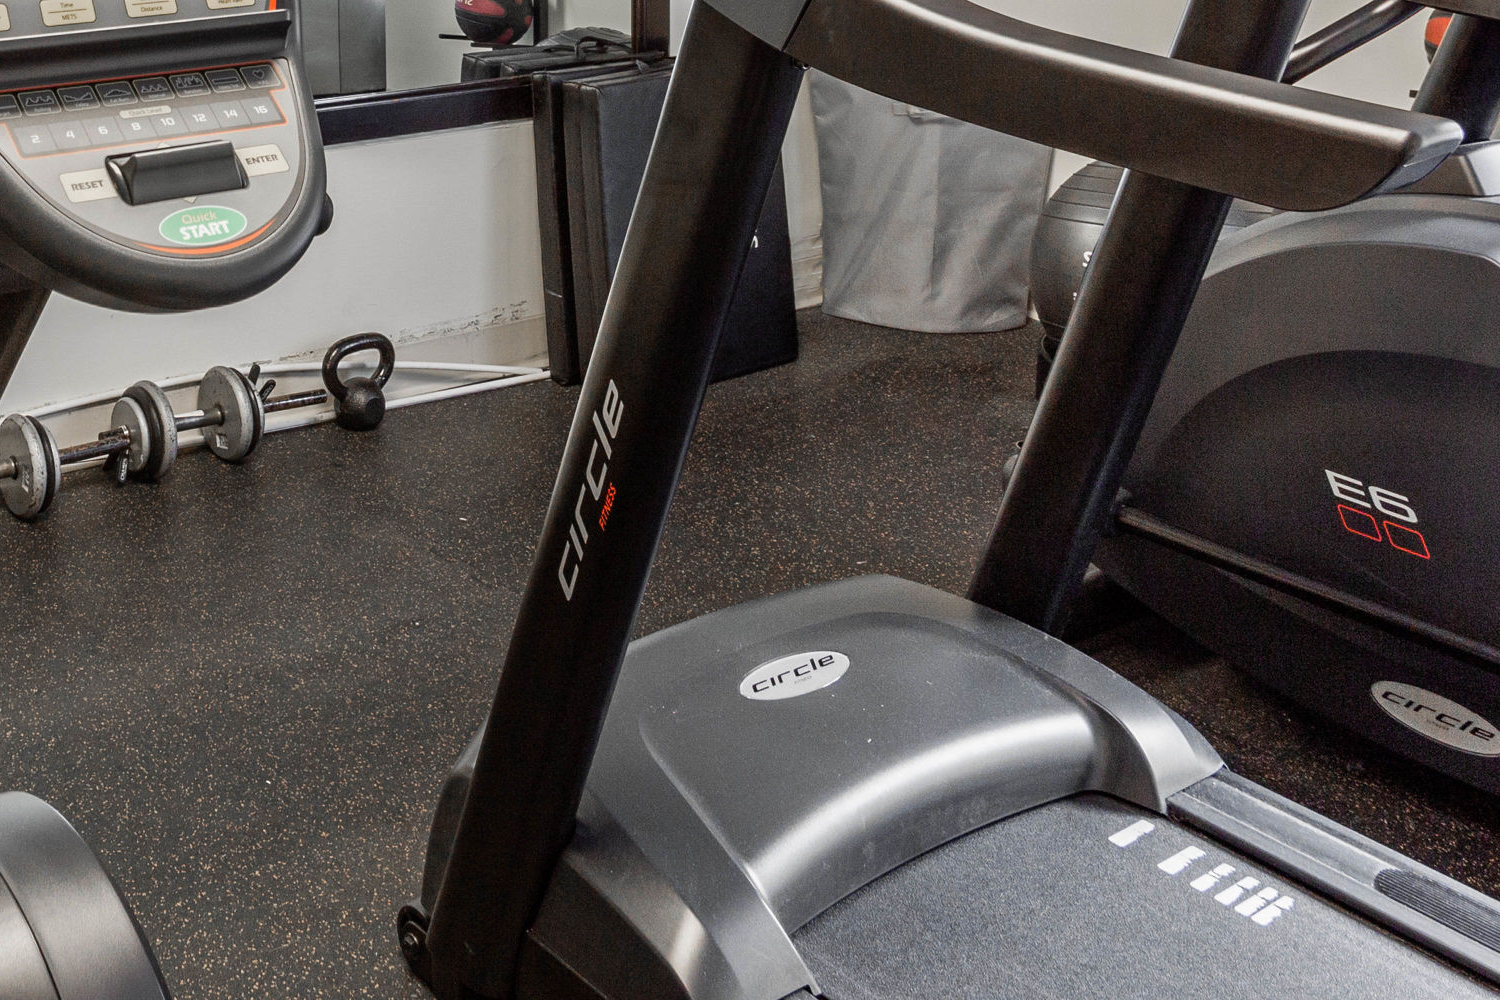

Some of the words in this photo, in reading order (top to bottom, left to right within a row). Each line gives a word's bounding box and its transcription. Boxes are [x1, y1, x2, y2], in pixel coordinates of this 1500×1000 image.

[59, 1, 74, 9] Time
[140, 5, 163, 13] Distance
[30, 134, 41, 144] 2
[66, 130, 75, 139] 4
[98, 126, 108, 135] 6
[131, 121, 141, 131] 8
[160, 117, 176, 126] 10
[192, 113, 208, 123] 12
[223, 109, 238, 119] 14
[253, 105, 268, 115] 16
[245, 154, 279, 165] ENTER
[71, 180, 104, 192] RESET
[179, 220, 230, 241] START
[180, 210, 217, 225] Quick
[558, 379, 624, 601] circle
[1324, 469, 1418, 523] E6
[598, 481, 617, 532] FITNESS
[752, 655, 835, 693] circle
[1381, 691, 1496, 742] circle
